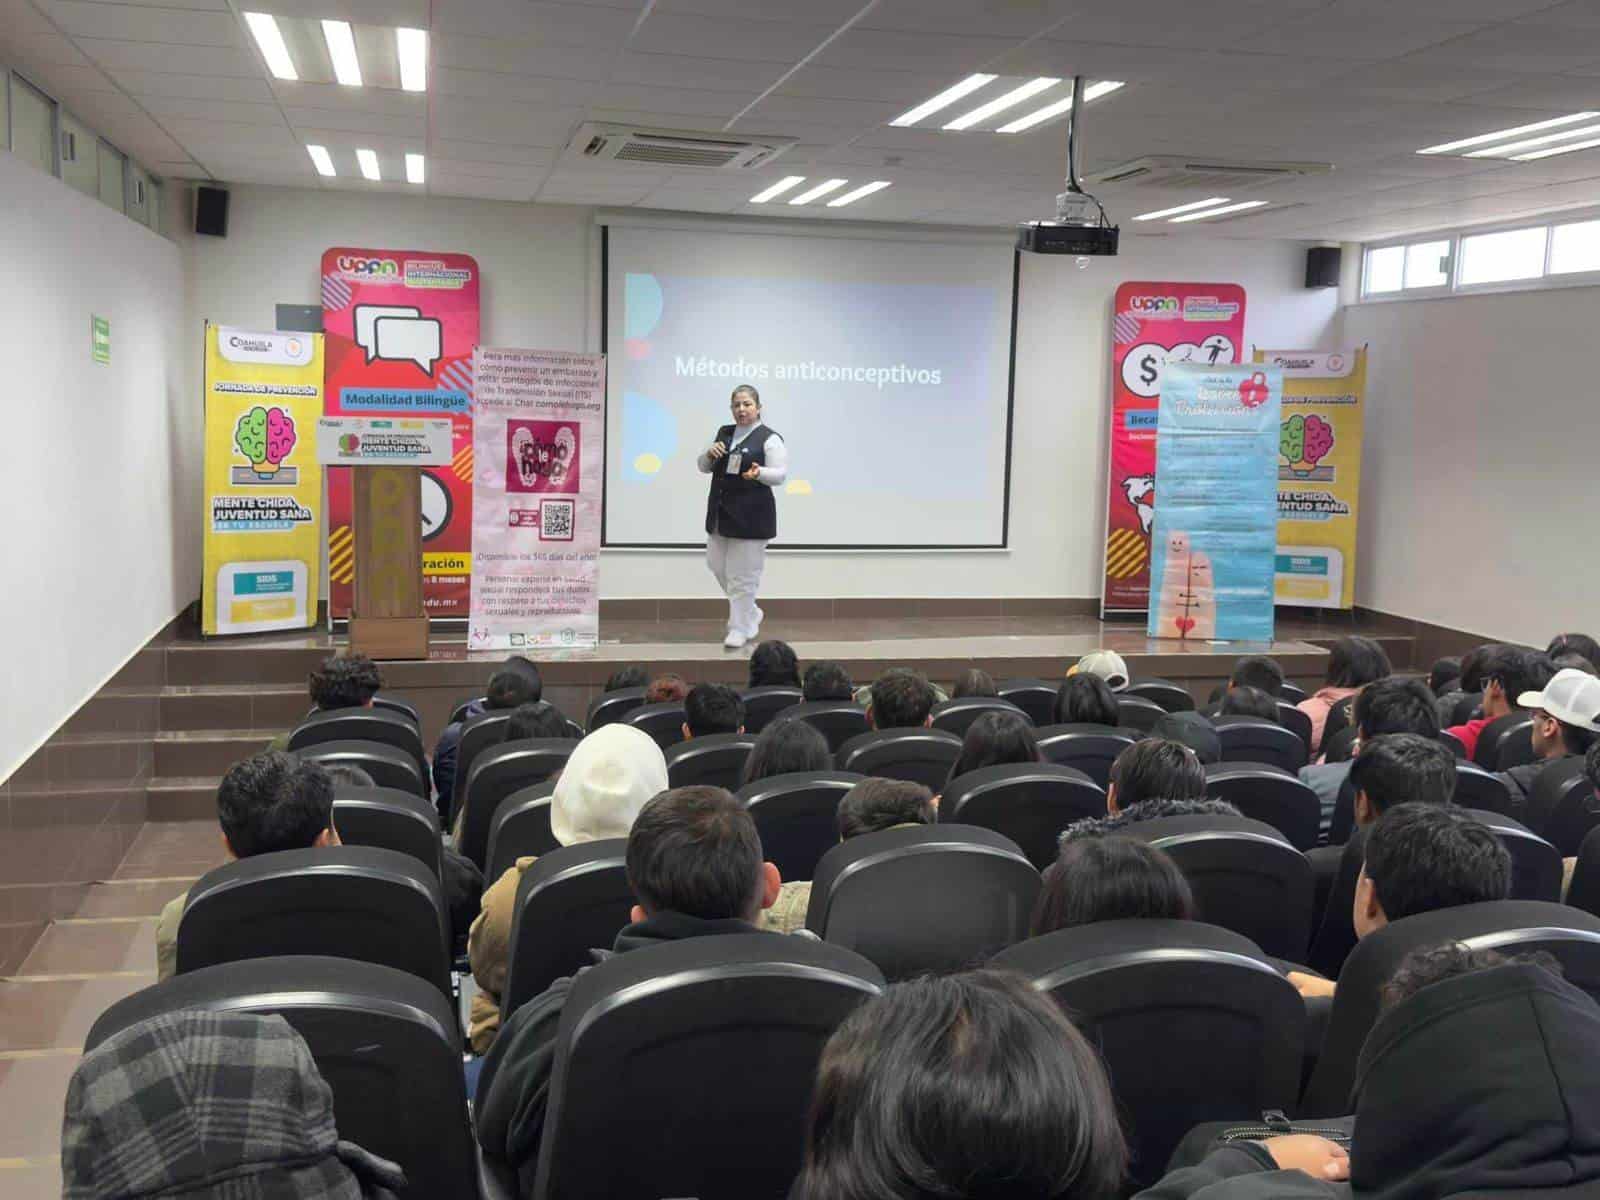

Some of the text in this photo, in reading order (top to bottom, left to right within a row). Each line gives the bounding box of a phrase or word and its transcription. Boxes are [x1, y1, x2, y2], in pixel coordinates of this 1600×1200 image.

[674, 356, 942, 390] Métodos anticonceptivos
[346, 392, 466, 408] Modalidad Bilingüe
[214, 496, 297, 509] MENTE CHIDA,
[1314, 502, 1347, 512] SANA
[214, 509, 312, 520] JUVENTUD SANA
